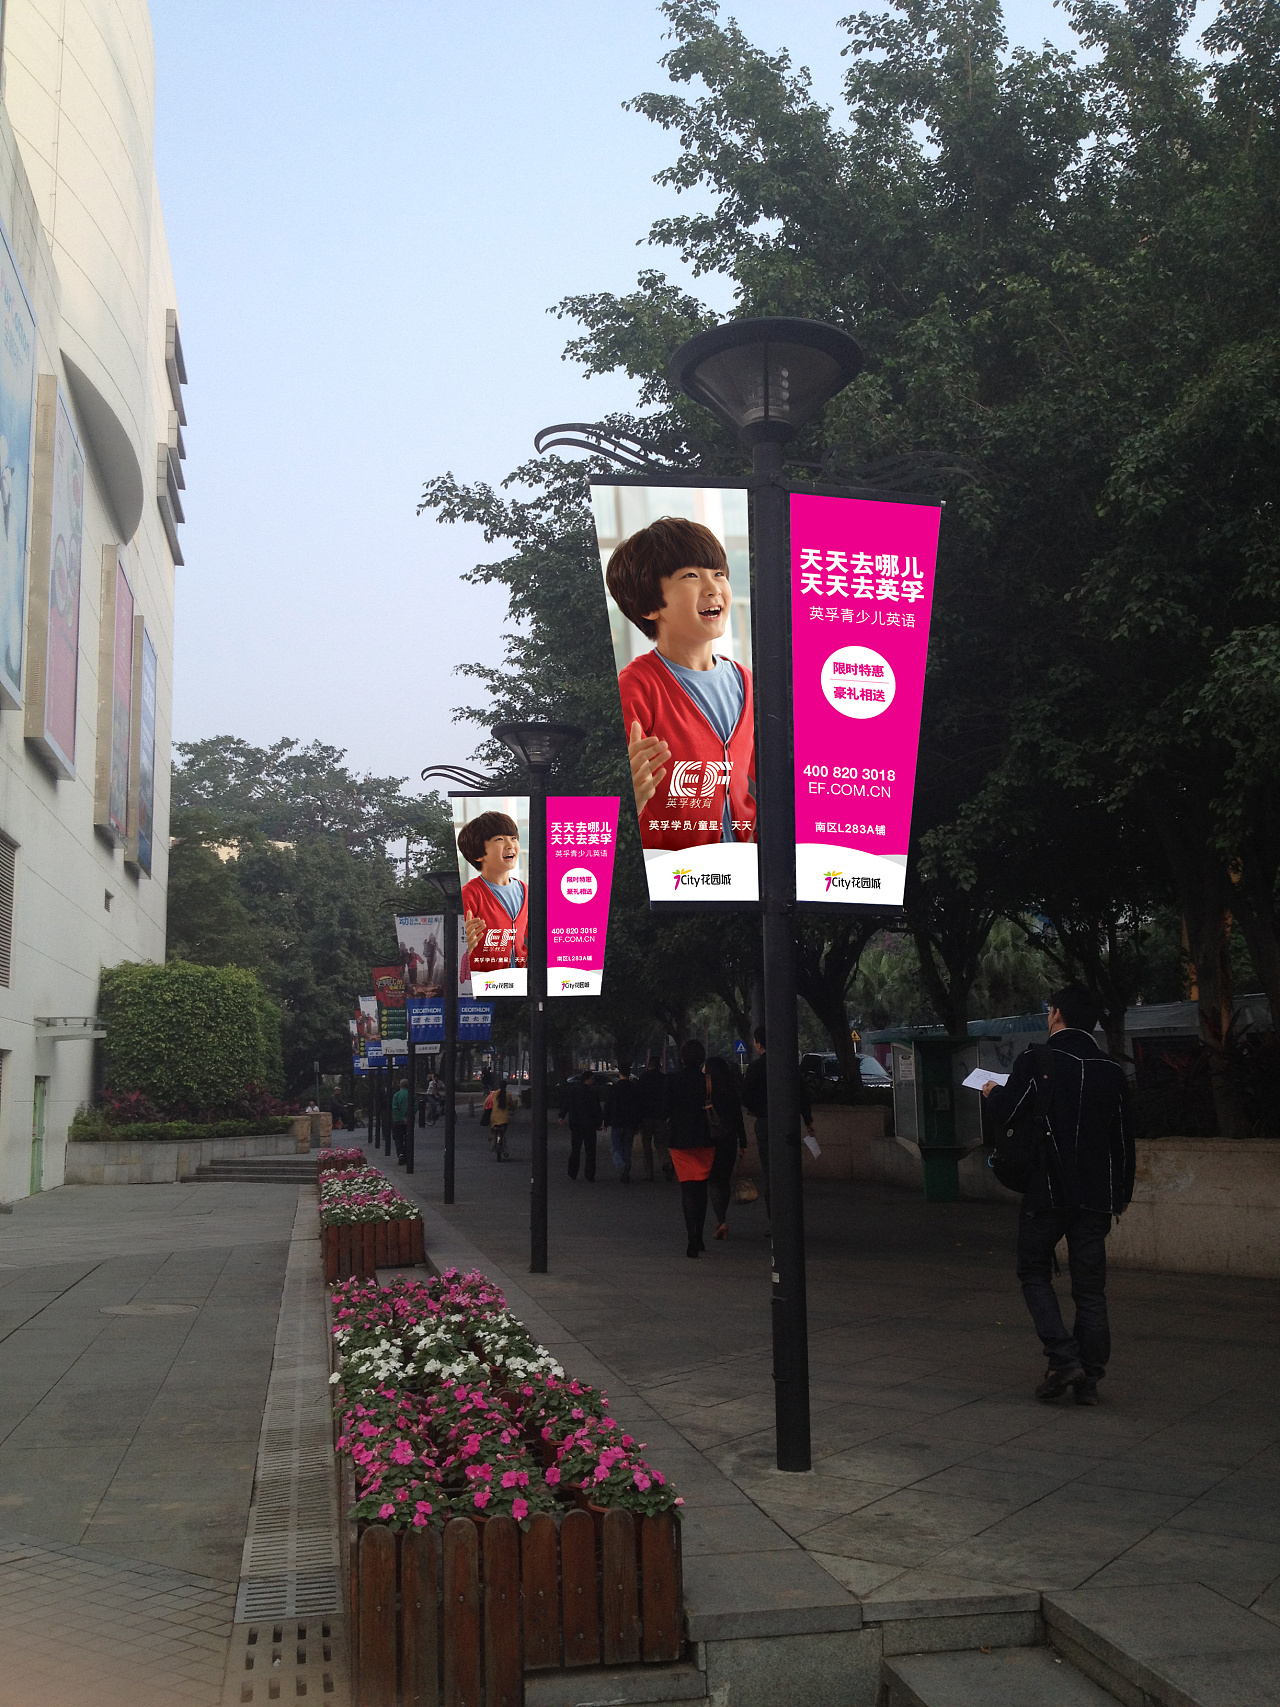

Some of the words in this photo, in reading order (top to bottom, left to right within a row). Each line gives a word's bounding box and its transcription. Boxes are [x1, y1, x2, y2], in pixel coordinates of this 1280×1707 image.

[800, 548, 924, 578] 天天去哪儿
[800, 572, 924, 603] 天天去英孚
[809, 605, 916, 628] 英孚青少儿英语
[833, 661, 884, 678] 限时特惠
[833, 686, 886, 703] 豪礼相送
[668, 761, 734, 797] EF
[803, 764, 828, 777] 400
[832, 766, 858, 779] 820
[861, 768, 896, 781] 3018
[808, 781, 891, 798] EF.COM.CN
[665, 798, 713, 809] 英孚教育
[551, 821, 612, 833] 天天去哪儿
[815, 821, 886, 836] 南区L283A铺
[551, 833, 612, 845] 天天去英孚
